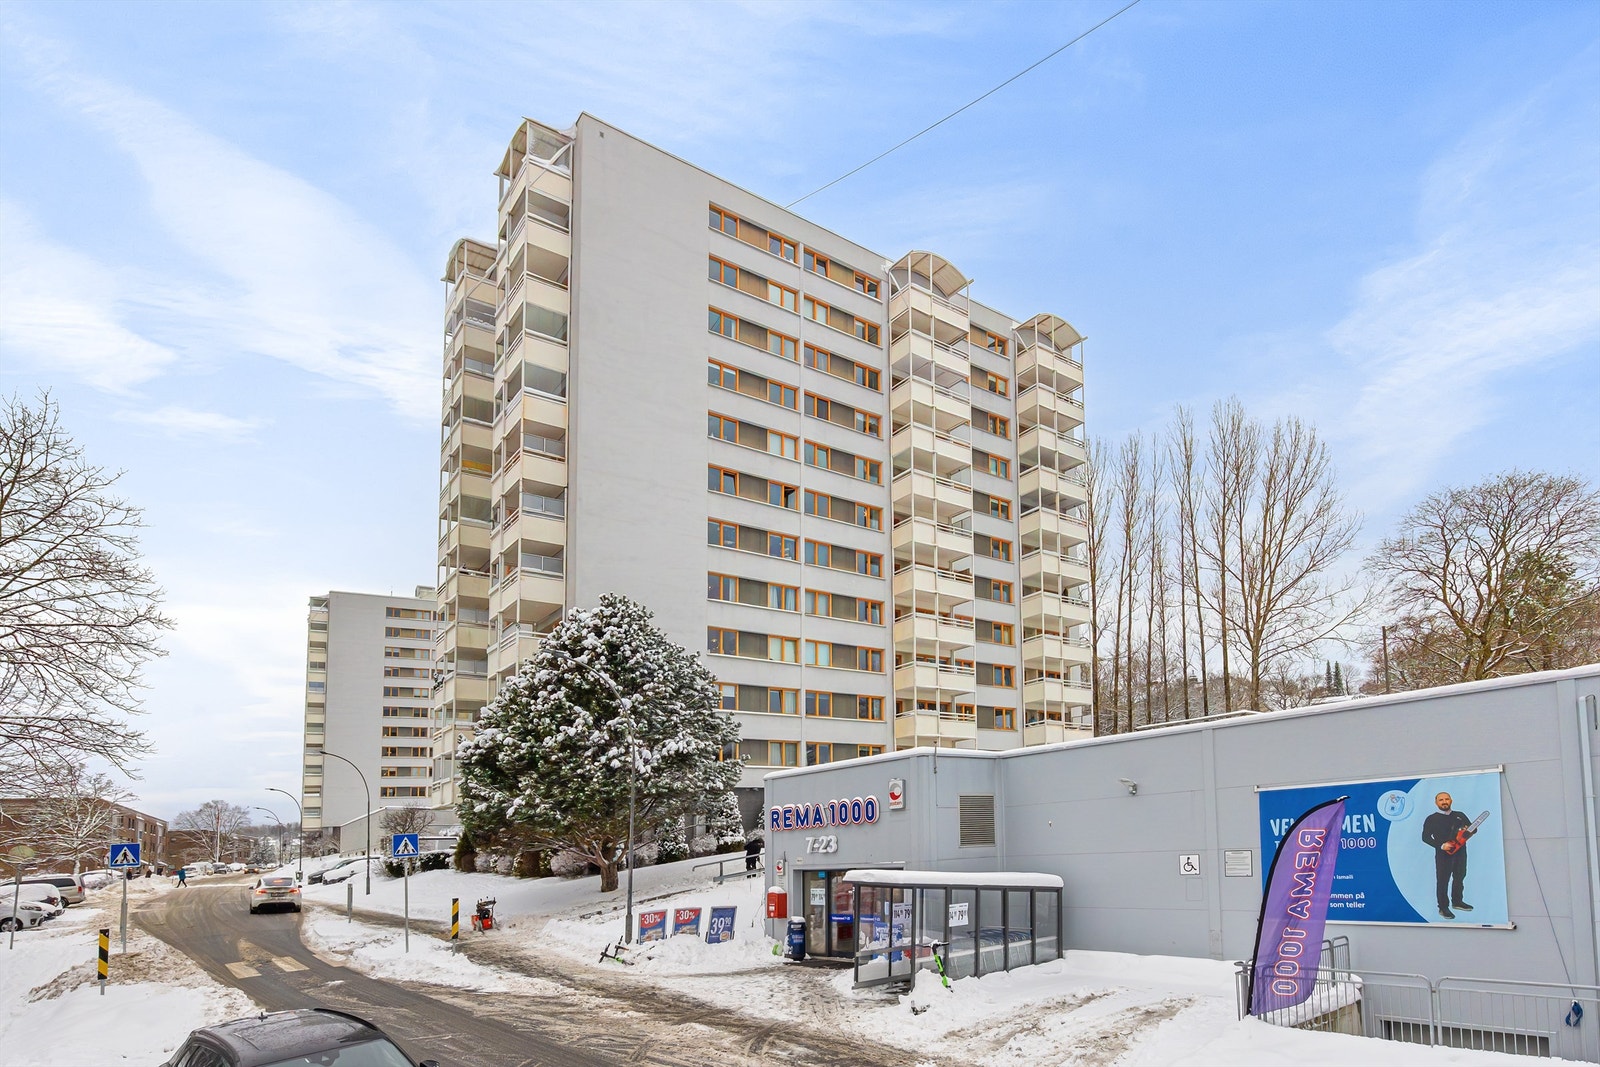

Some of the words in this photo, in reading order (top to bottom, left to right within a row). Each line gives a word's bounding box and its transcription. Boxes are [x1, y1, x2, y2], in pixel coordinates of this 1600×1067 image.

[770, 803, 825, 831] REMA
[828, 797, 877, 826] 1000
[805, 835, 838, 854] 7-23
[1341, 837, 1376, 849] 1000
[1355, 891, 1366, 900] på
[641, 913, 661, 925] -30%
[676, 910, 695, 920] -30%
